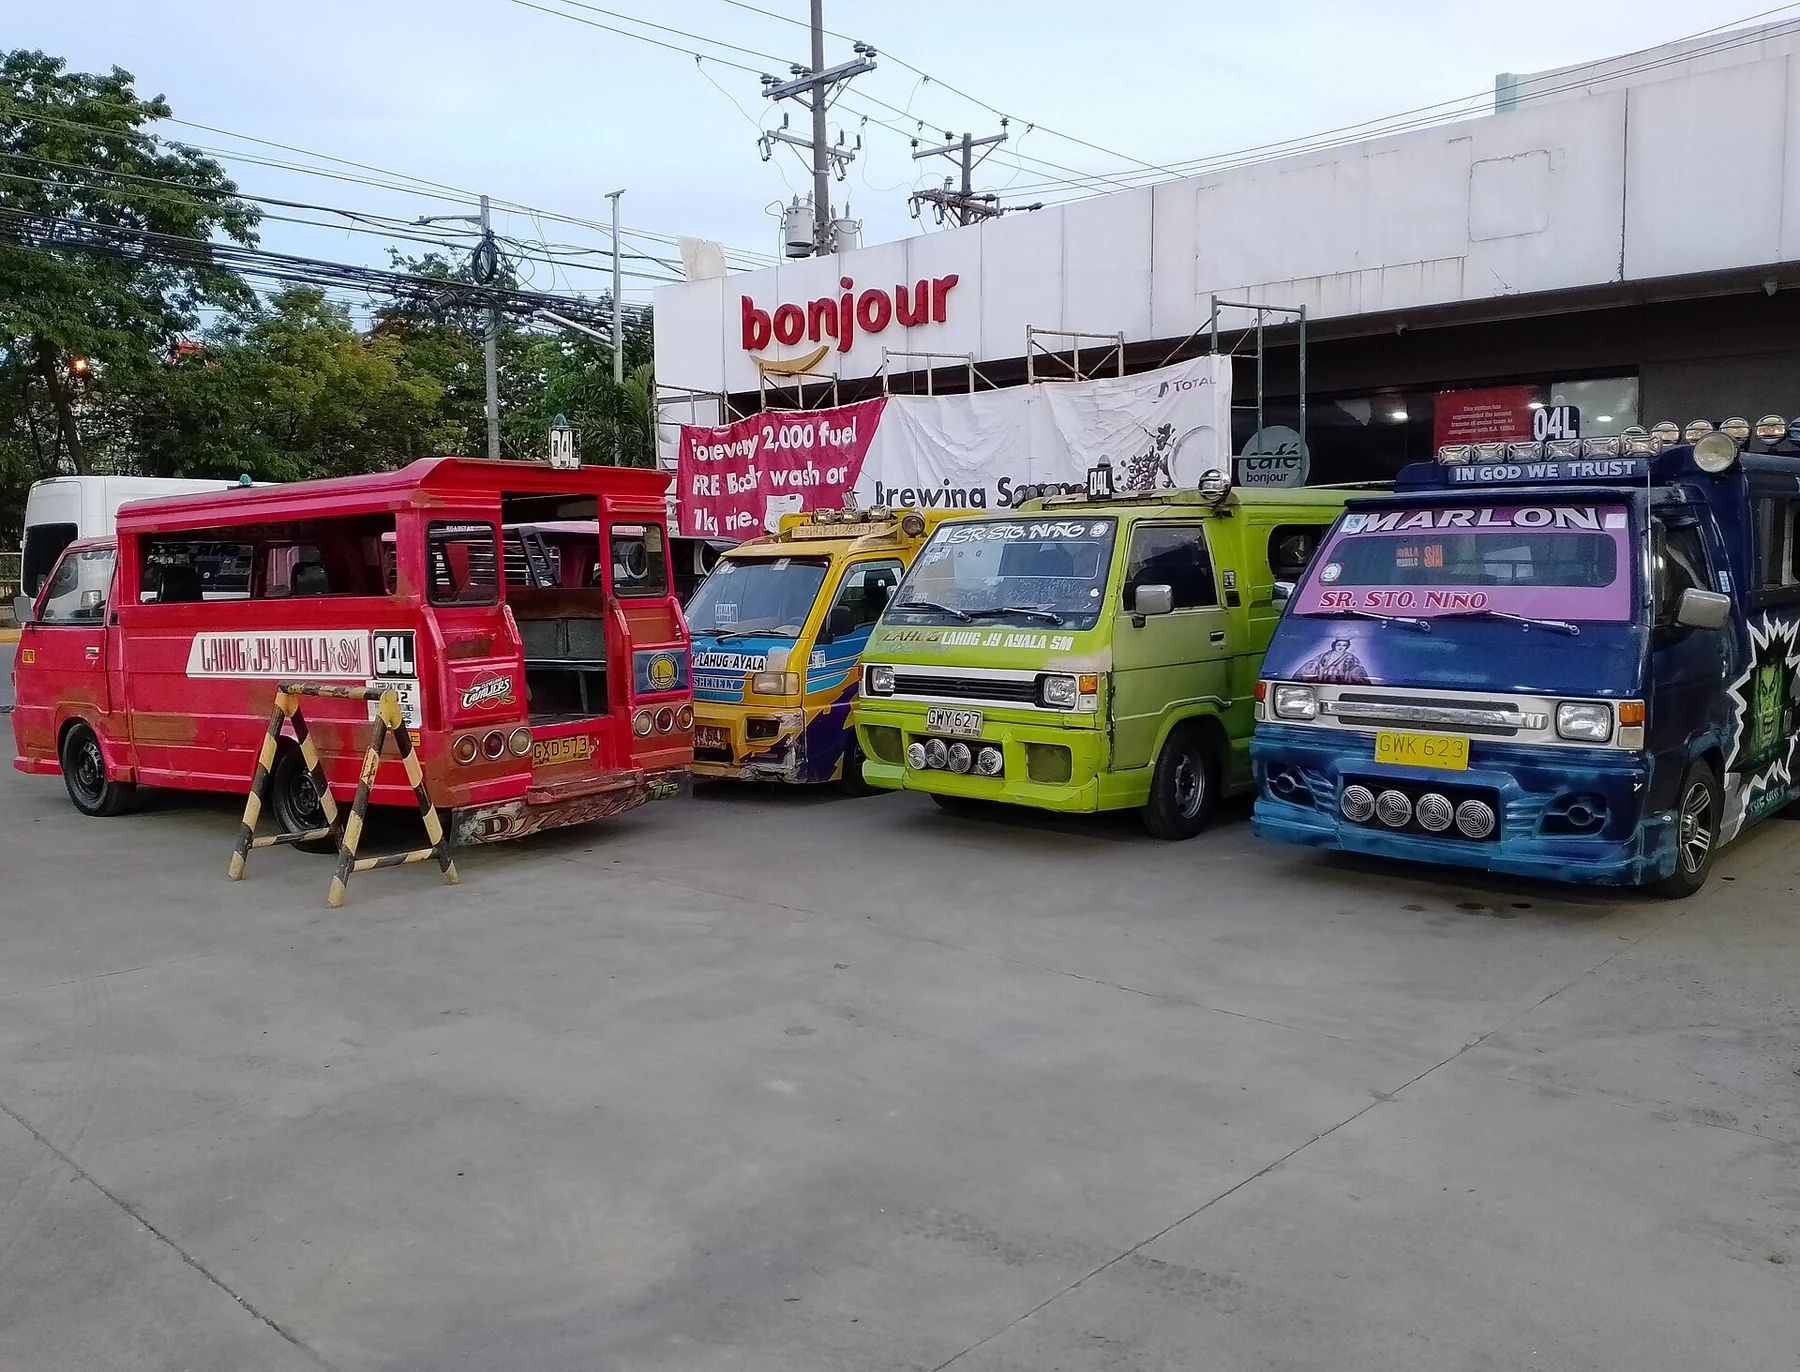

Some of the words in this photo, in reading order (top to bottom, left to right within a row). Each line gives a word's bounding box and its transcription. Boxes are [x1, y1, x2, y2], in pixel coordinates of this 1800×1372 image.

[741, 274, 959, 353] bonjour
[1173, 377, 1217, 392] TOTAL
[762, 424, 814, 452] 2,000
[819, 416, 857, 447] fuel
[1534, 406, 1577, 441] 04L
[551, 429, 579, 467] 04L
[1246, 442, 1299, 470] café
[770, 460, 819, 487] wash
[826, 466, 848, 484] or
[1089, 470, 1110, 496] 04L
[1246, 471, 1288, 484] bonjour
[1456, 468, 1475, 481] IN
[1480, 466, 1522, 480] GOD
[1527, 464, 1559, 478] WE
[1568, 460, 1636, 477] TRUST
[1349, 506, 1608, 533] MARLON
[1319, 590, 1357, 609] SR.
[1364, 590, 1417, 609] STO.
[940, 631, 981, 646] LAHUG
[1003, 633, 1047, 649] AYALA
[1050, 635, 1074, 651] SM
[201, 638, 245, 672] LAHUG
[279, 638, 329, 672] AYALA
[374, 636, 413, 674] 04L
[928, 710, 953, 726] GWY
[954, 712, 980, 728] 627
[534, 740, 560, 759] GXD
[562, 737, 588, 754] 573
[1379, 734, 1418, 755] GWK
[1423, 737, 1465, 758] 623
